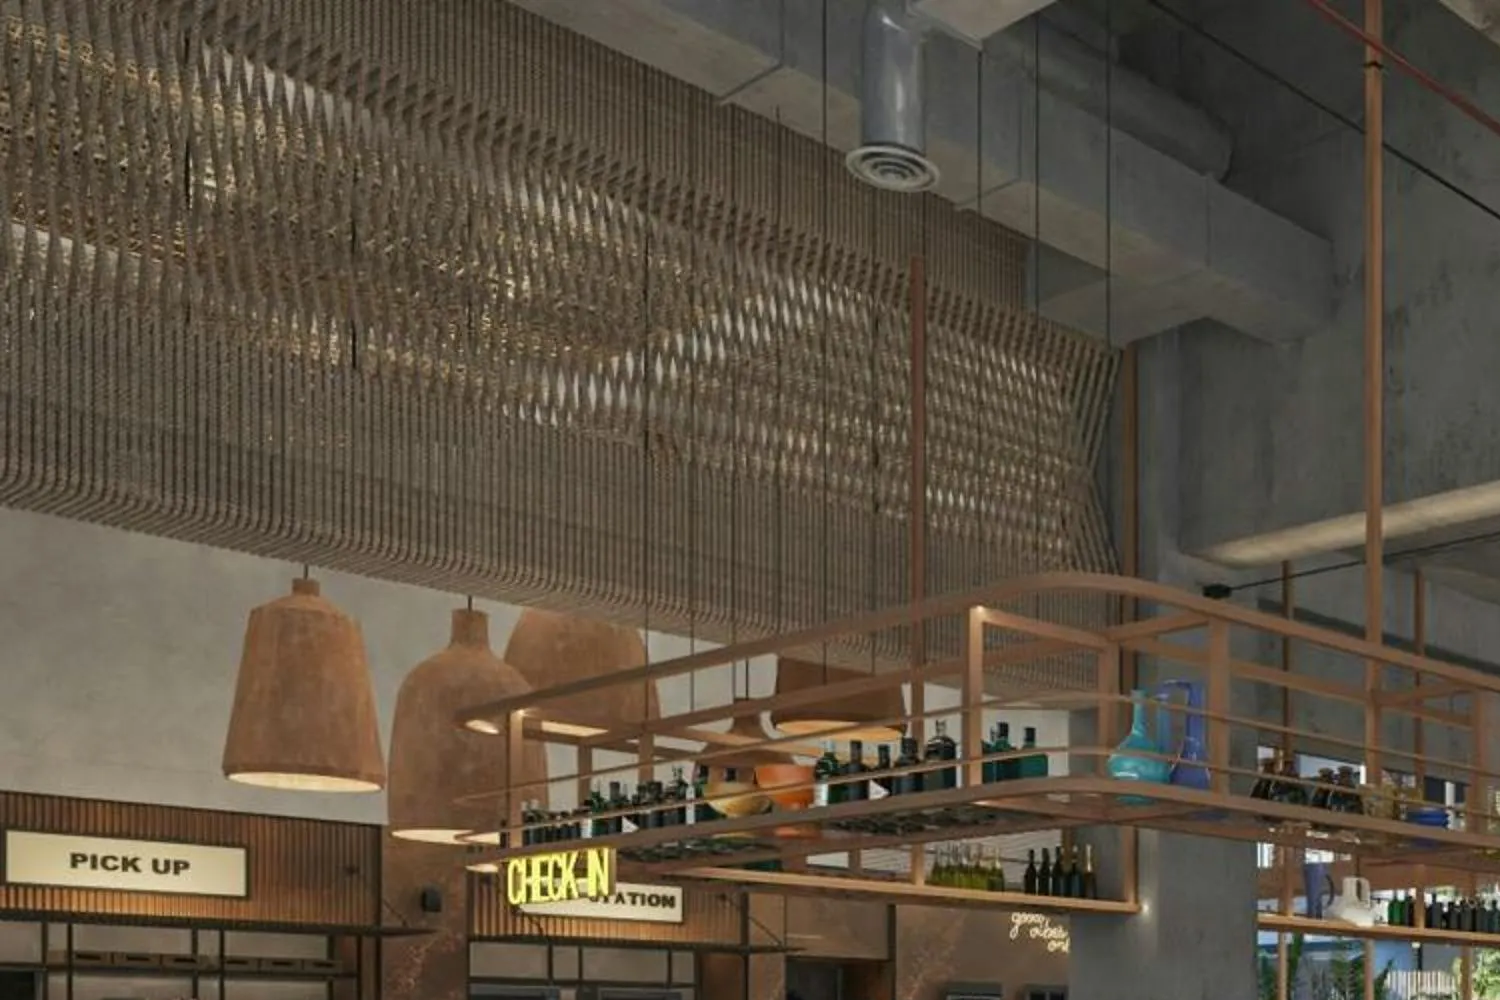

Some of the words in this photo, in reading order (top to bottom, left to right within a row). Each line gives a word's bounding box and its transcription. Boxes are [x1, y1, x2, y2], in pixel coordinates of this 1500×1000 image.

[69, 852, 142, 873] PICK
[151, 858, 191, 876] UP
[589, 892, 676, 909] ATION
